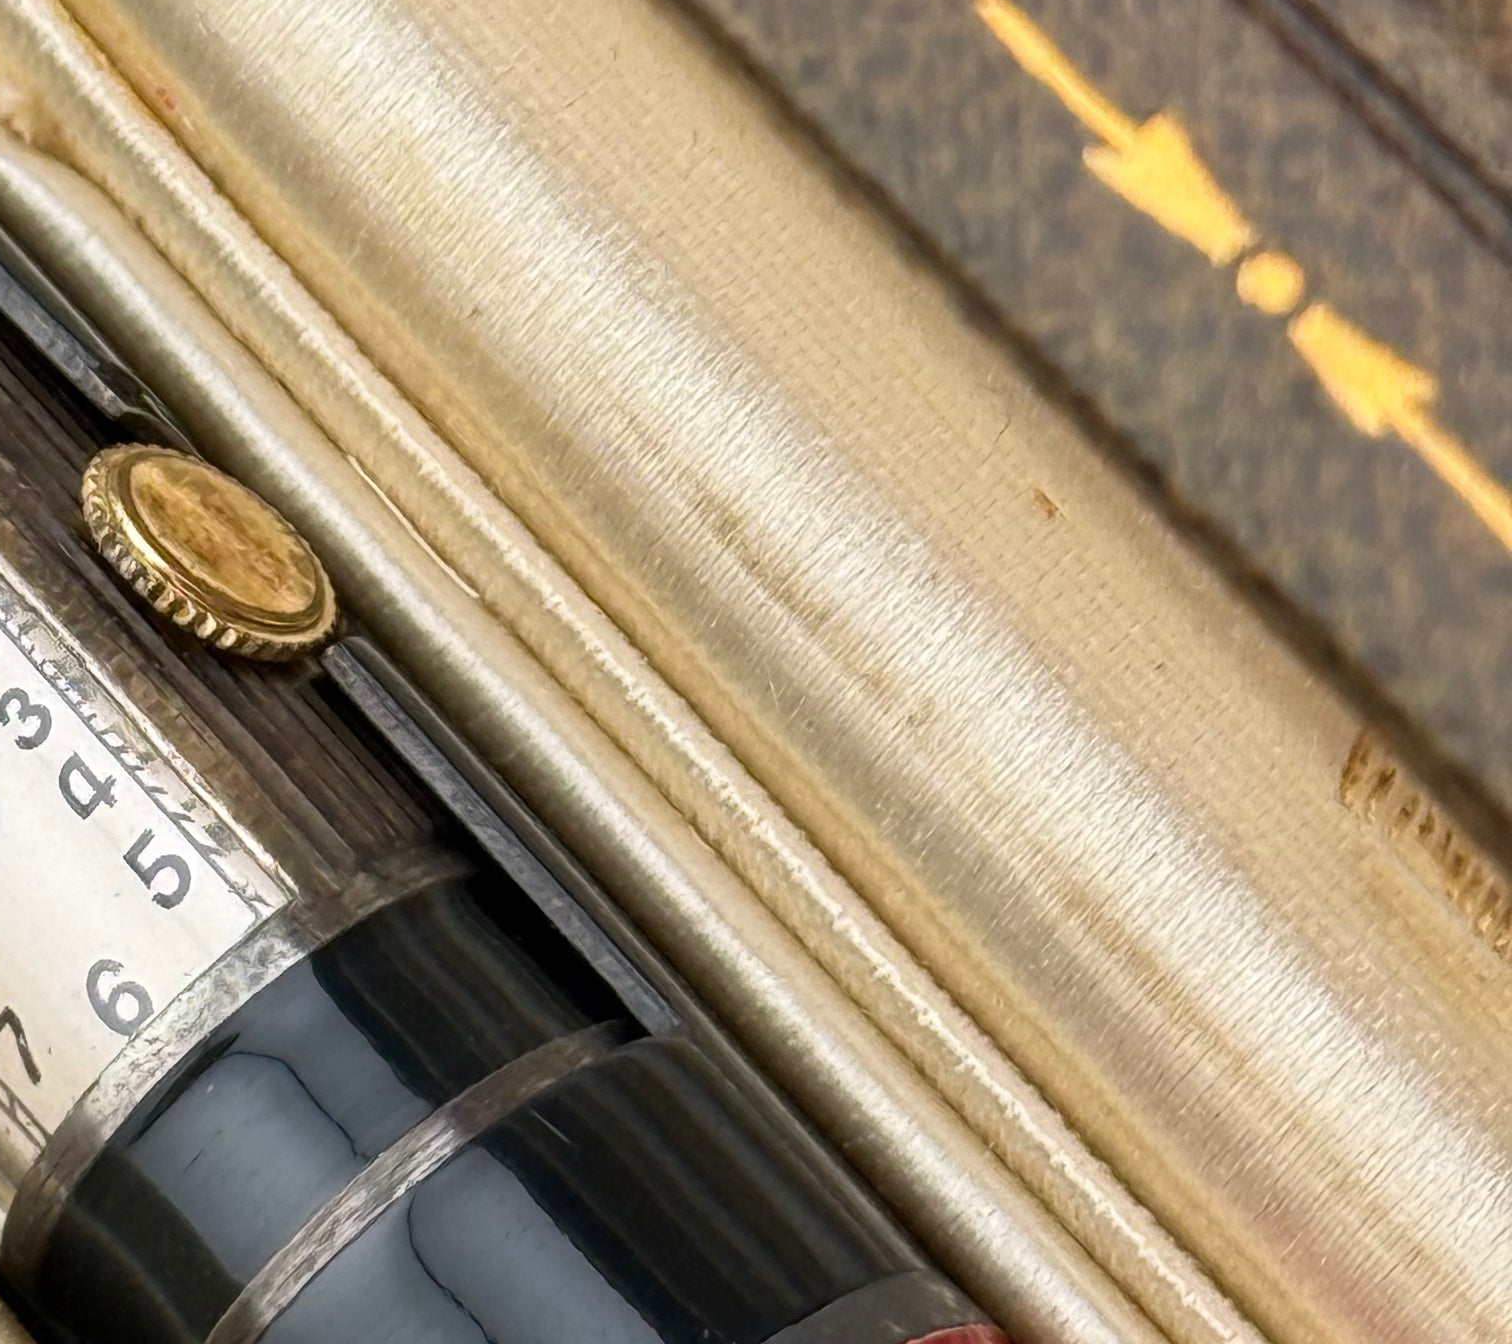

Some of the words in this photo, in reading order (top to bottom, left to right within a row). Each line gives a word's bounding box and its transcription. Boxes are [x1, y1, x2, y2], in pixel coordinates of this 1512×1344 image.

[58, 751, 117, 820] 4
[123, 828, 192, 910] 5
[86, 959, 155, 1038] 6
